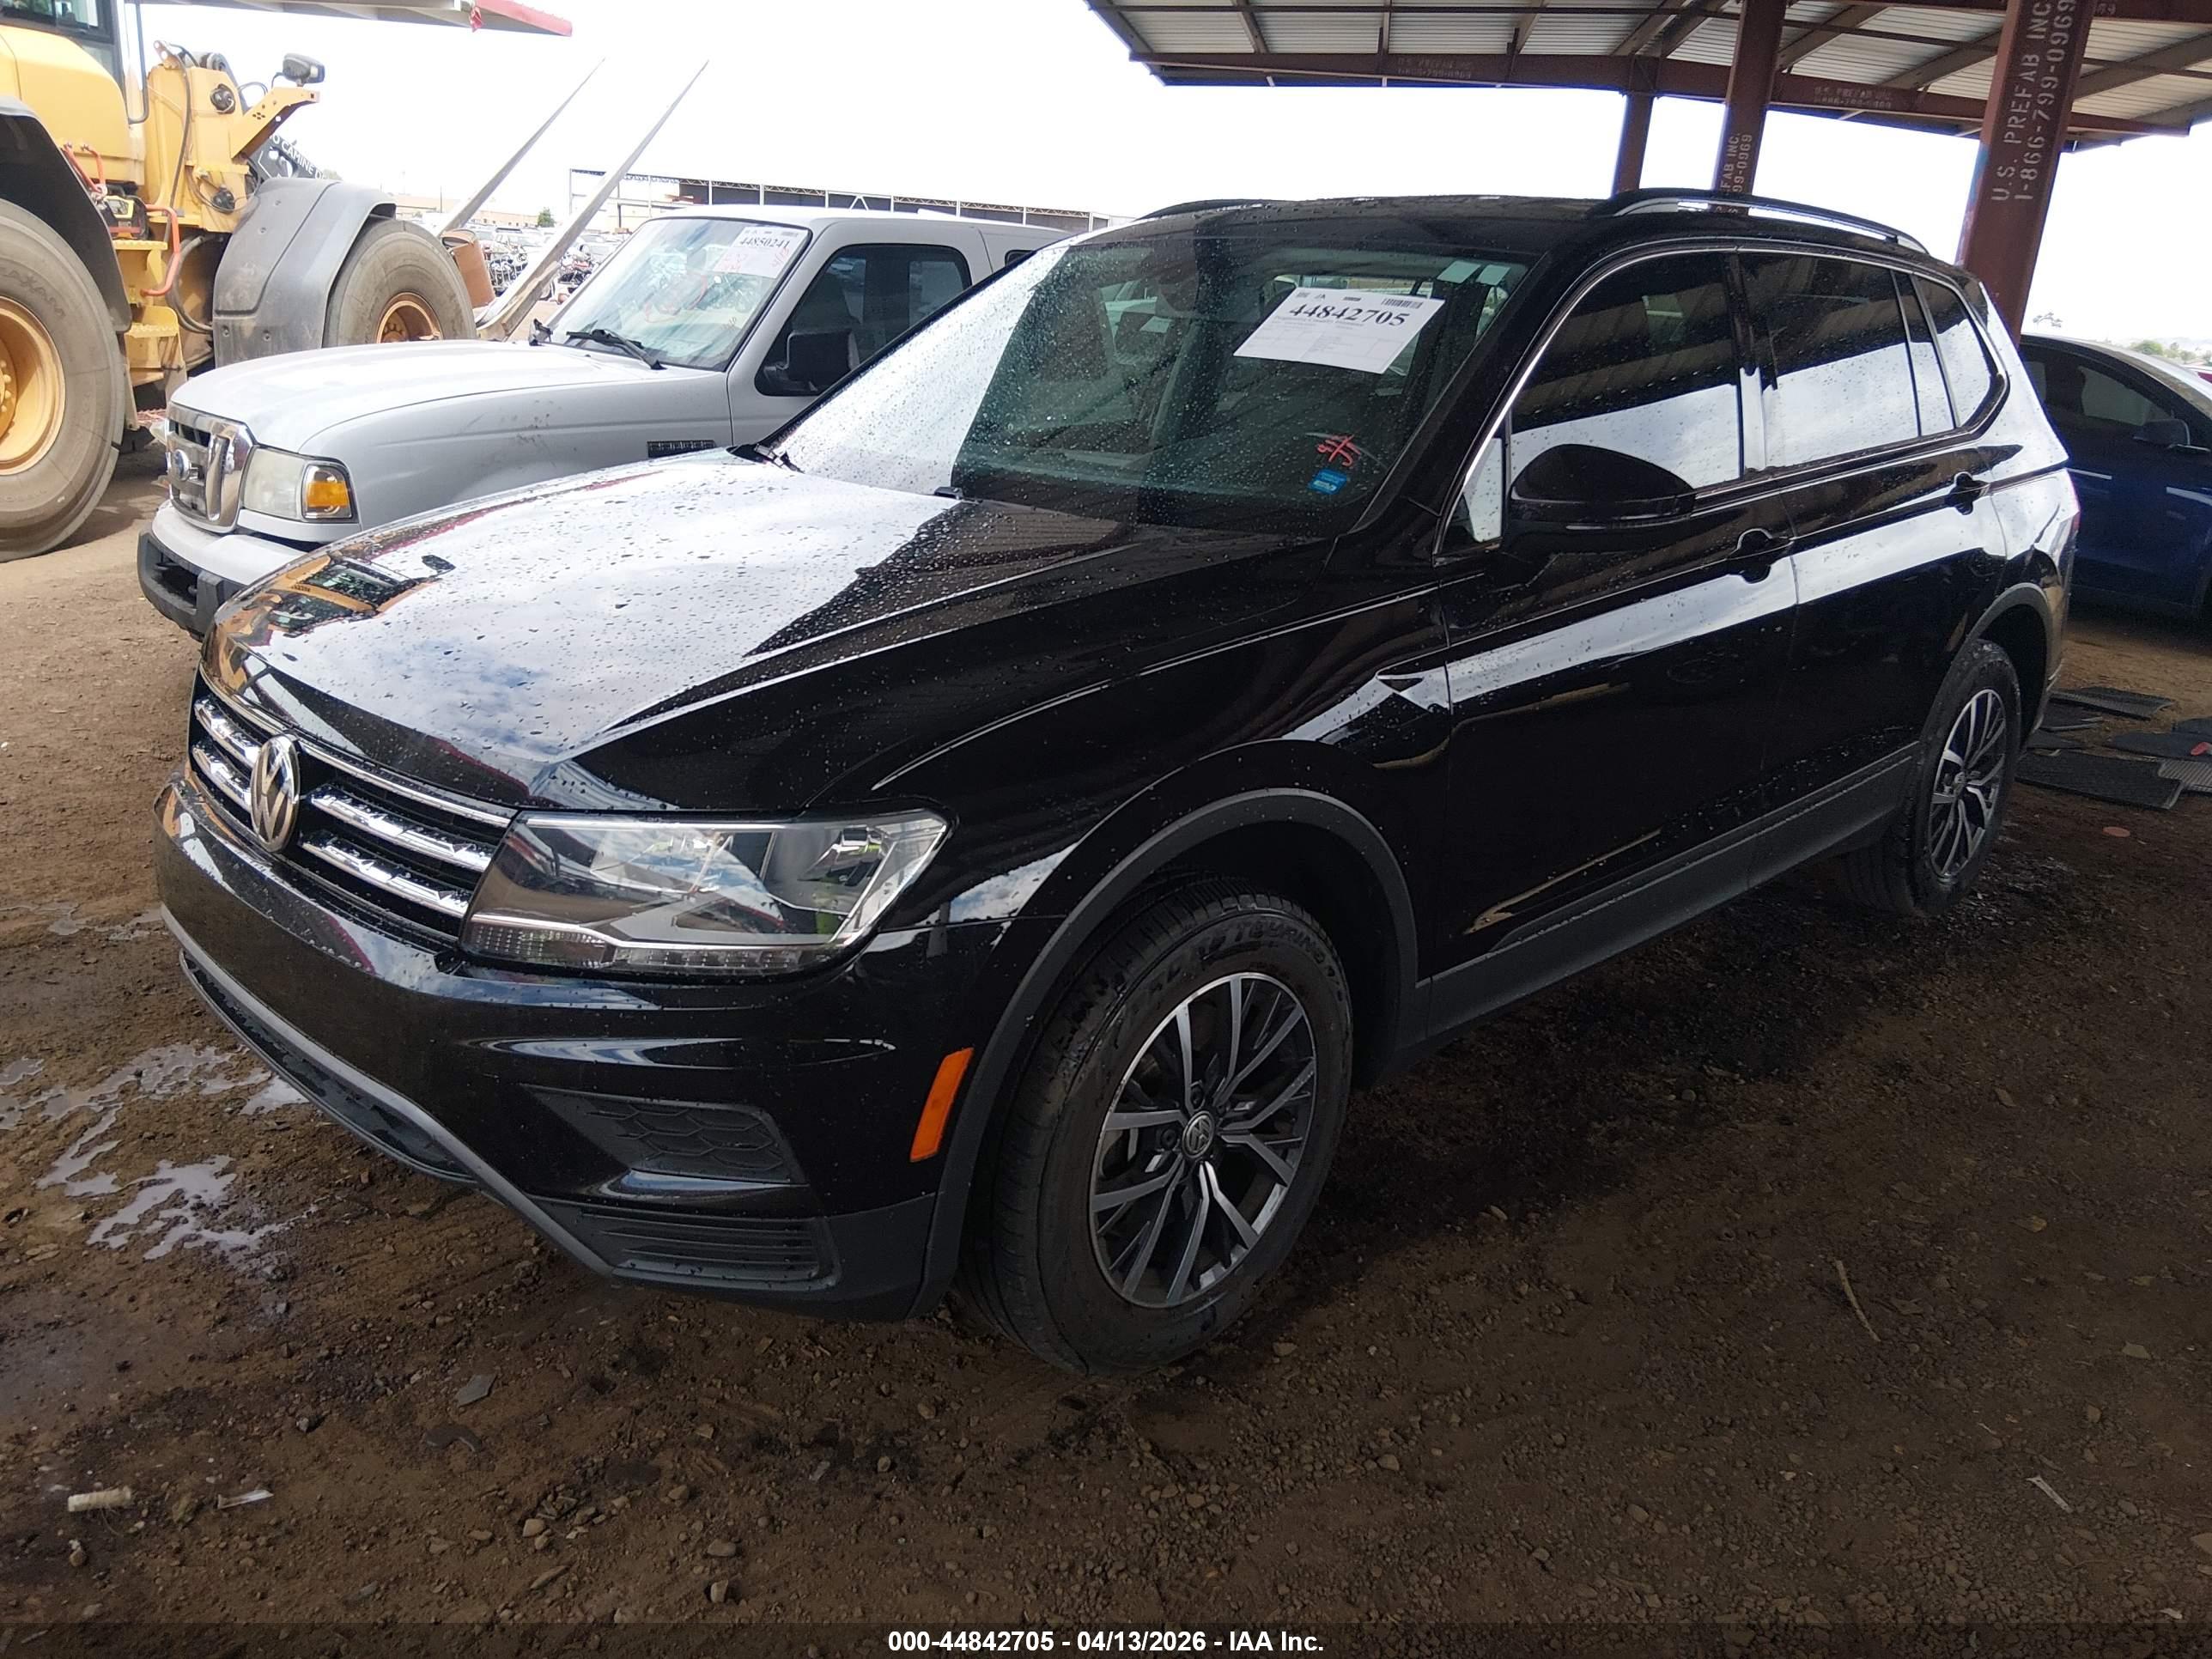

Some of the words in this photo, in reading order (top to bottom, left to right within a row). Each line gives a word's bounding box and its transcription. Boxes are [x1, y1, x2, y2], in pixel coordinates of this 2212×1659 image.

[2003, 54, 2040, 143] PREFAB
[282, 140, 316, 175] CAMINE
[1991, 159, 2018, 201] U.S.
[1289, 303, 1411, 326] 44842705
